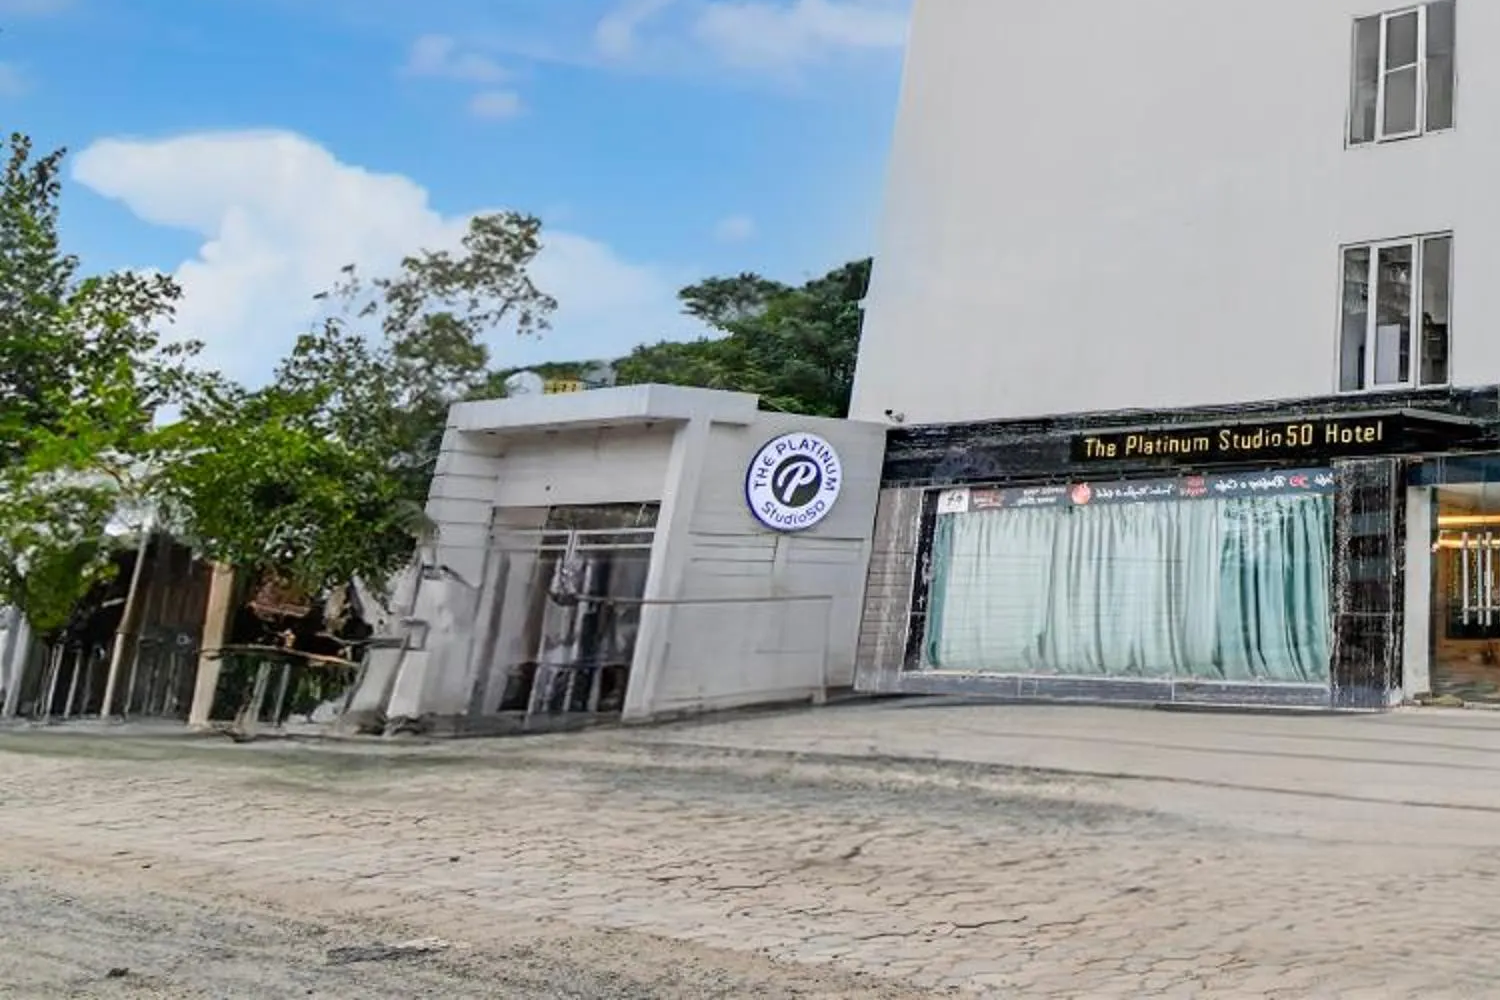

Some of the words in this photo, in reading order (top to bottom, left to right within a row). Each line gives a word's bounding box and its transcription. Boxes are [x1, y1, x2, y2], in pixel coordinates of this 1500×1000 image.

[1084, 437, 1117, 458] The
[1125, 434, 1209, 456] Platinum
[1325, 420, 1383, 444] Hotel
[753, 455, 775, 491] THE
[775, 438, 838, 492] PLATINUM
